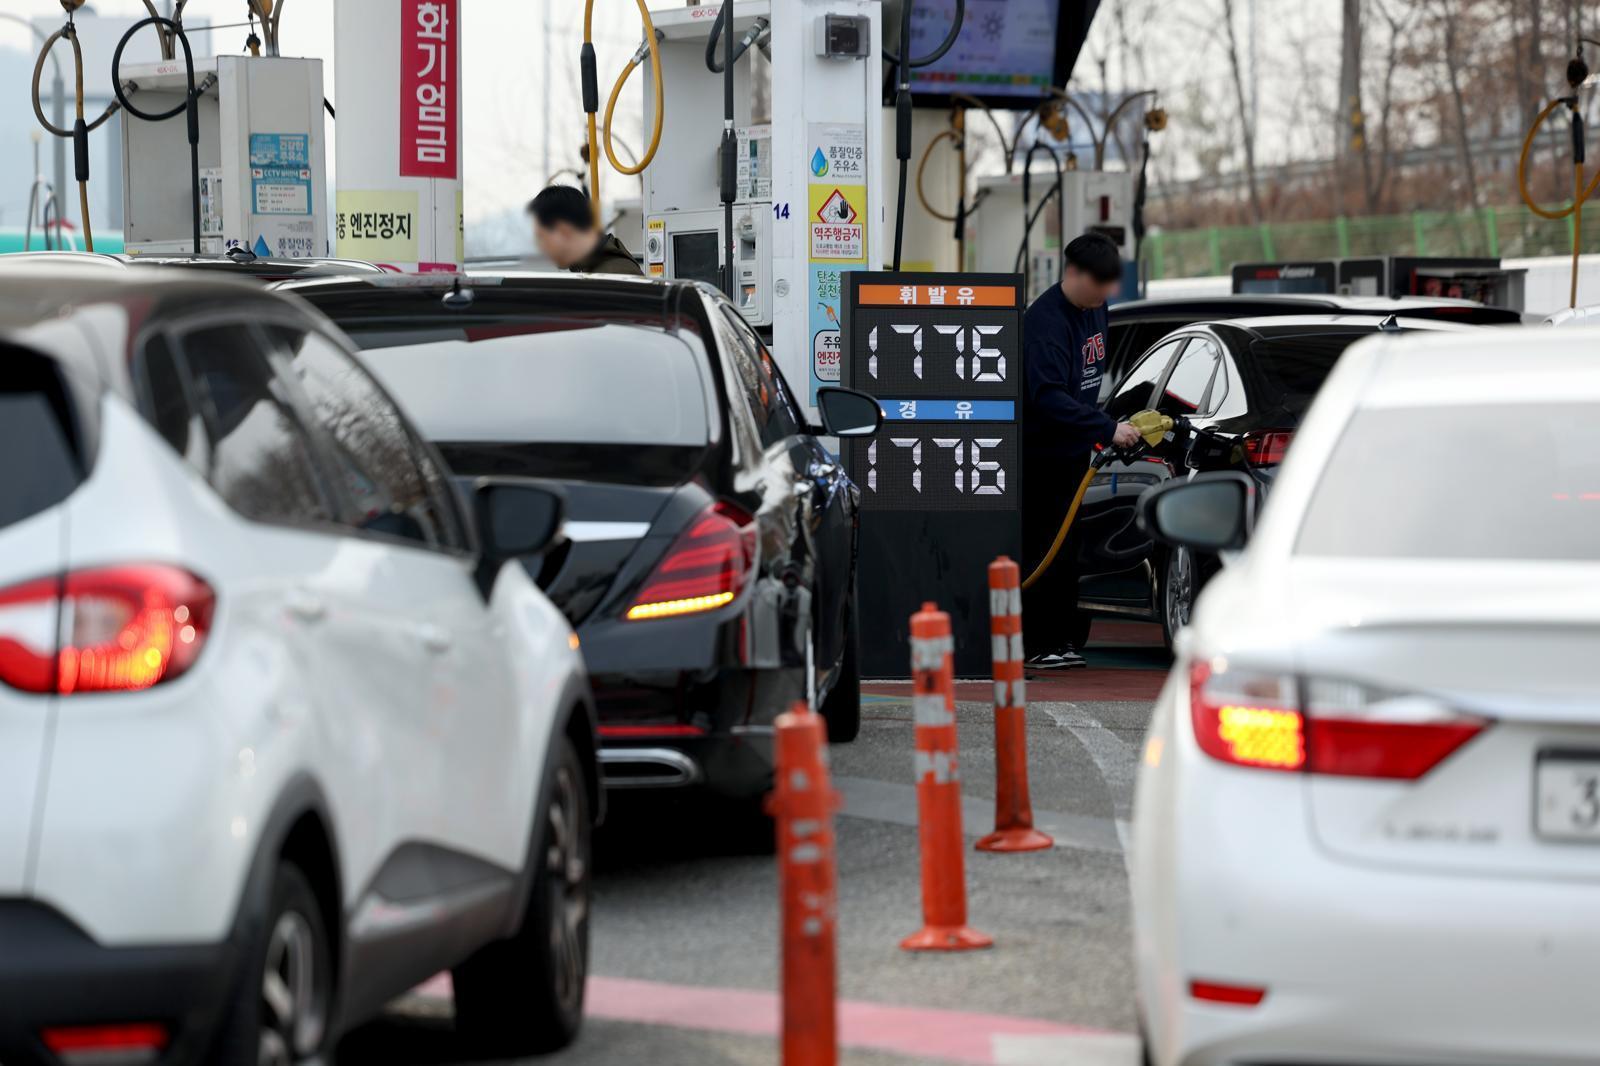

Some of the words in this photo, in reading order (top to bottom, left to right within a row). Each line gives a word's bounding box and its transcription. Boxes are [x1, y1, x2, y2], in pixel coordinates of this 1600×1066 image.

[416, 2, 449, 163] 화기엄금
[830, 146, 863, 160] 품질인증
[264, 169, 280, 177] CCTV
[833, 160, 859, 172] 주유소
[773, 203, 790, 220] 14
[350, 212, 411, 240] 엔진정지
[814, 226, 861, 241] 역주행금지
[817, 270, 841, 283] 탄소
[868, 324, 1007, 382] 1776
[867, 438, 1006, 494] 1776
